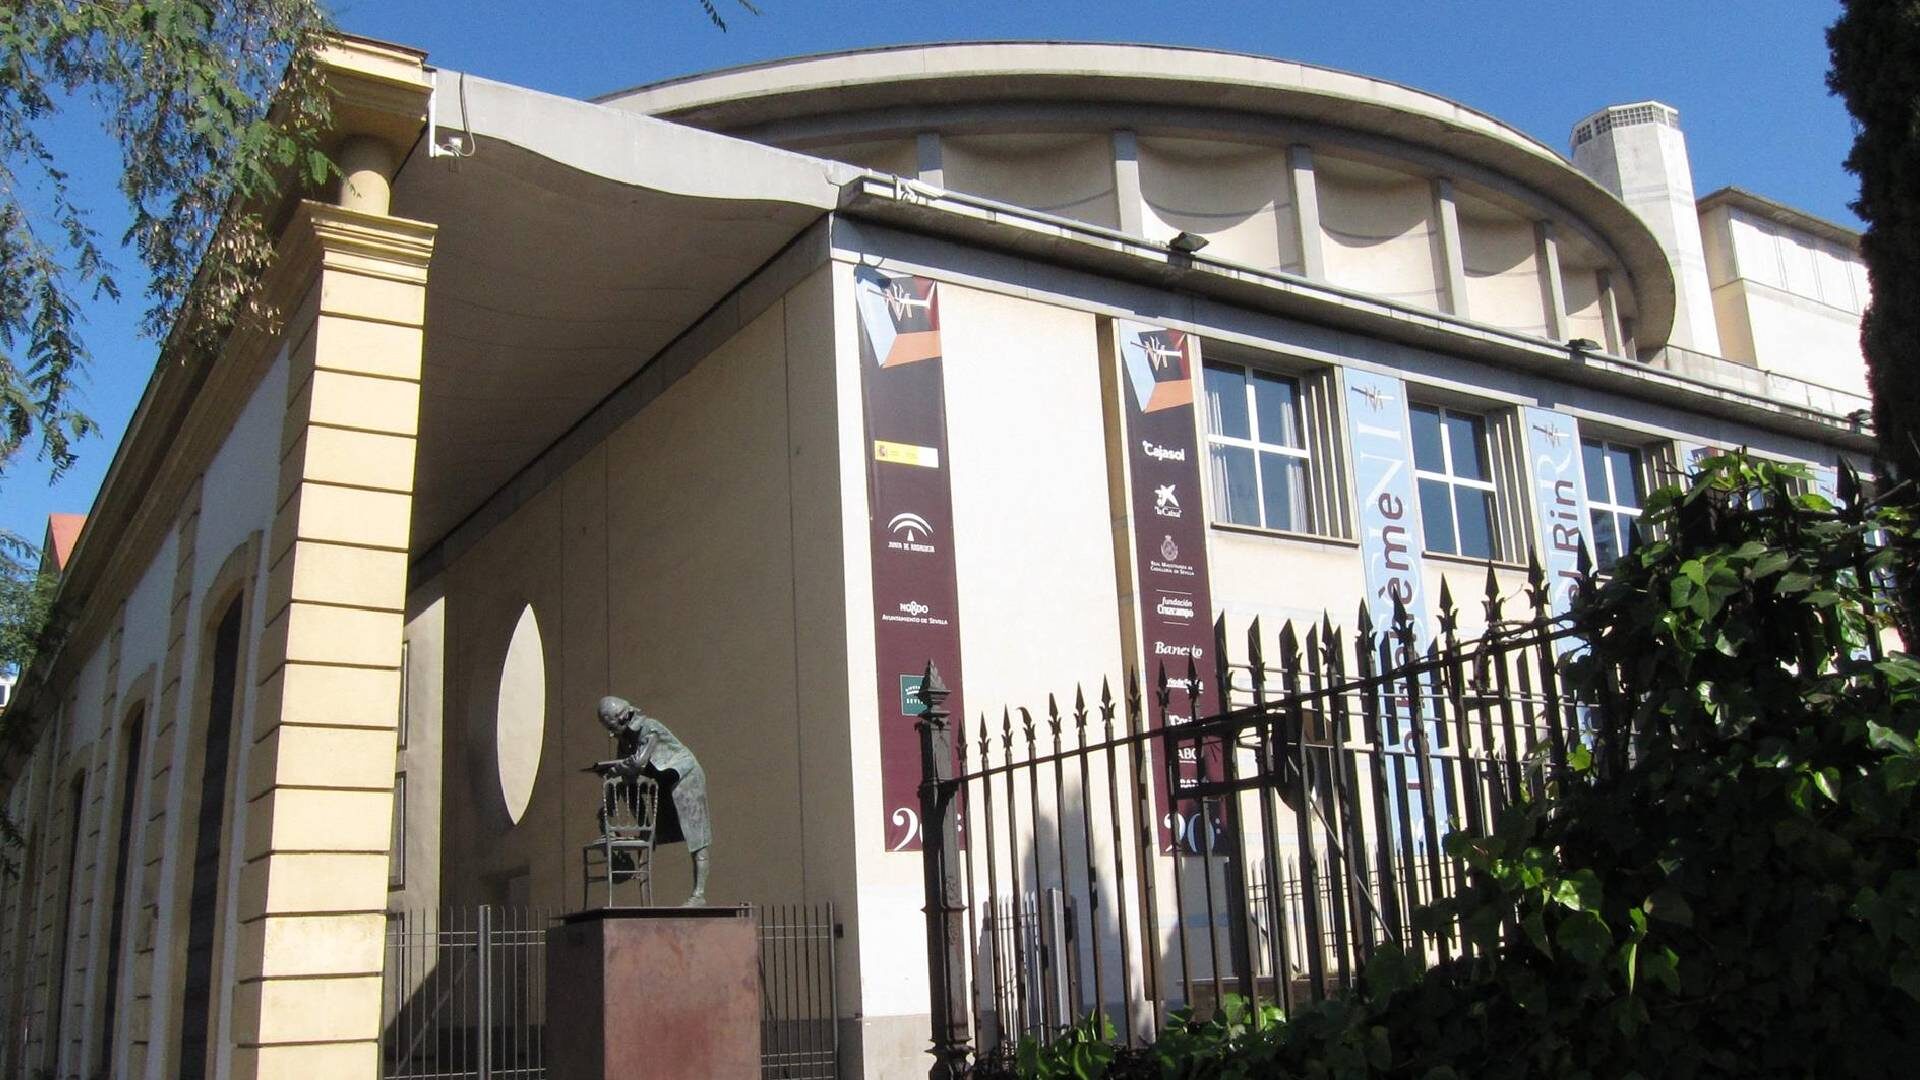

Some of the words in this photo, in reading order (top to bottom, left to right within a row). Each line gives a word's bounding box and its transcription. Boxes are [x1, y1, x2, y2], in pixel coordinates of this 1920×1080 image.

[1142, 441, 1185, 461] Cajasol
[1550, 479, 1579, 552] Rin
[1155, 641, 1203, 659] Banesto
